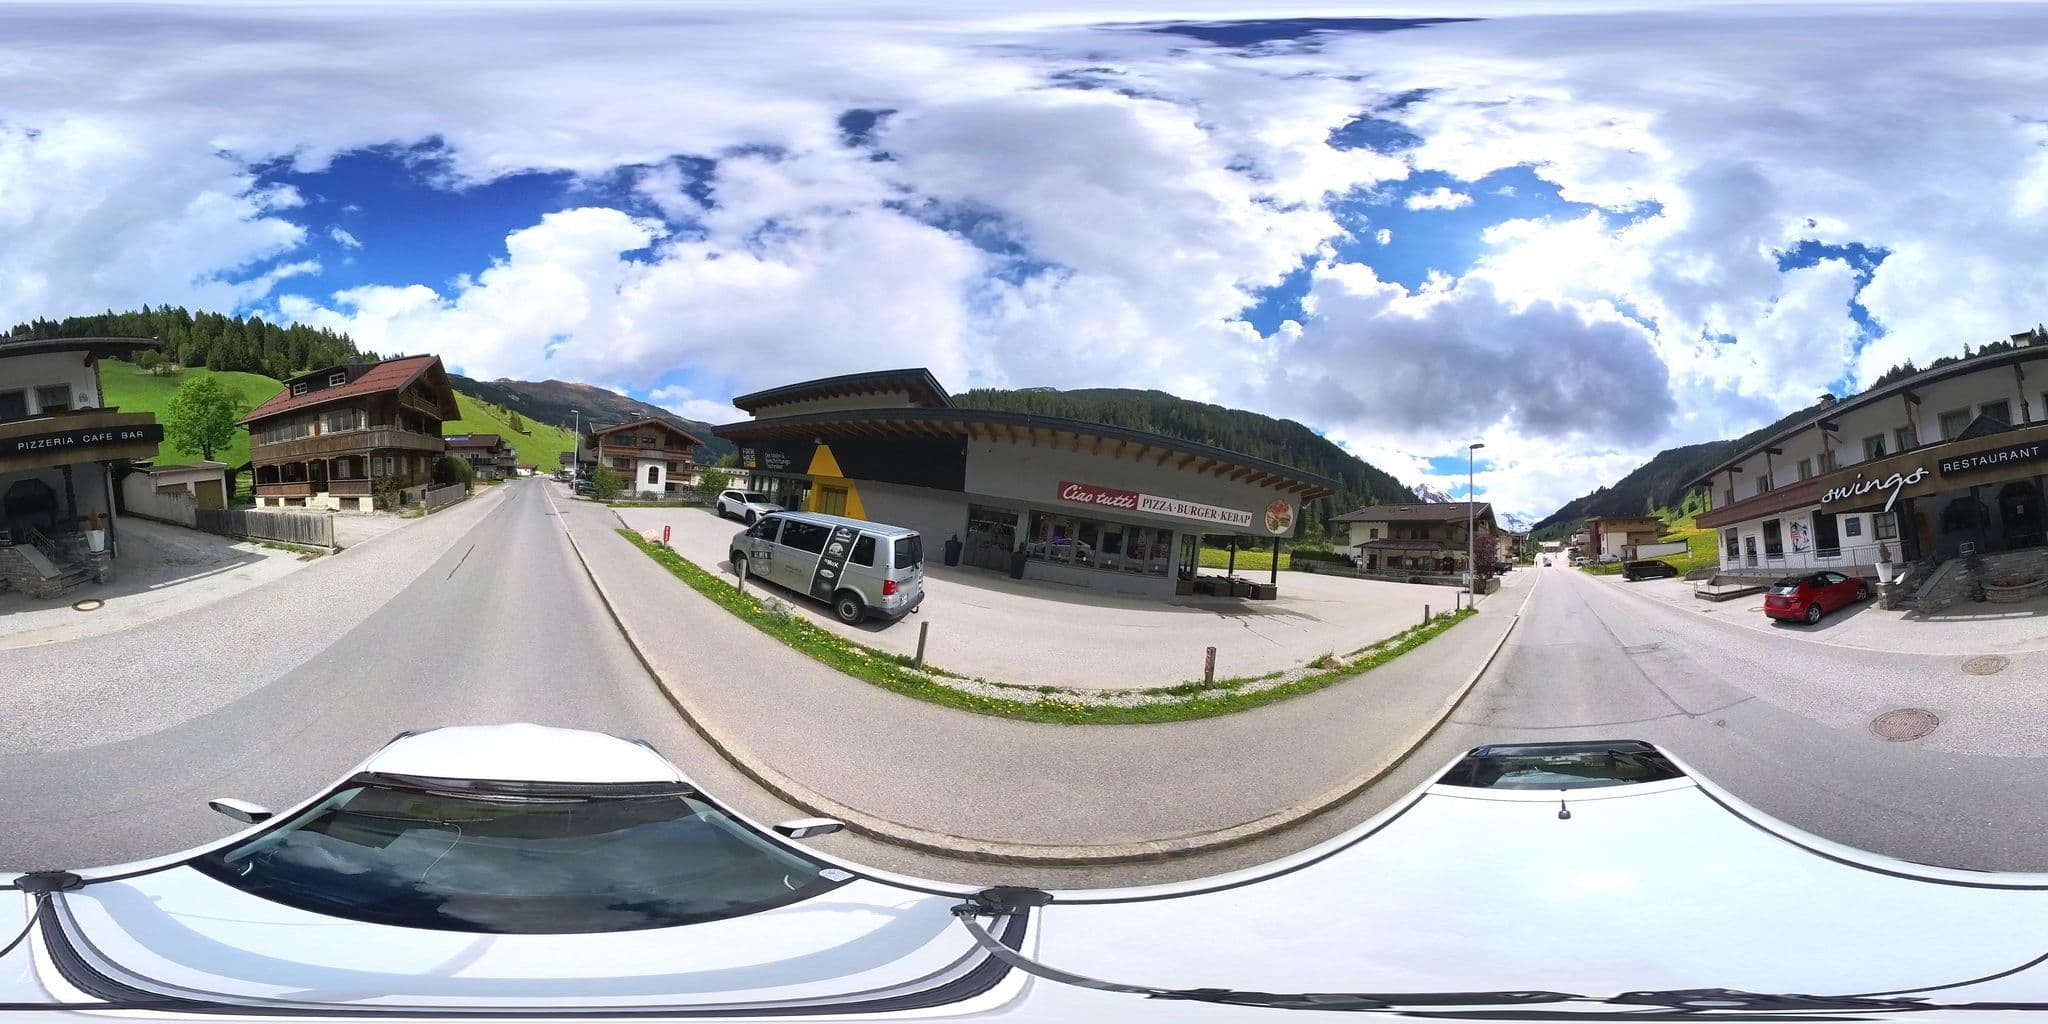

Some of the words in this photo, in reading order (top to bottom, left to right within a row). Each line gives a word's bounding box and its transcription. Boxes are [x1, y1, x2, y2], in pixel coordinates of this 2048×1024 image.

[17, 437, 74, 451] PIZZERIA
[82, 433, 113, 443] CAFE
[121, 431, 144, 440] BAR
[1943, 446, 2040, 473] RESTAURANT
[1063, 484, 1093, 502] Ciao
[1096, 491, 1137, 509] tutti
[1821, 466, 1930, 513] swings
